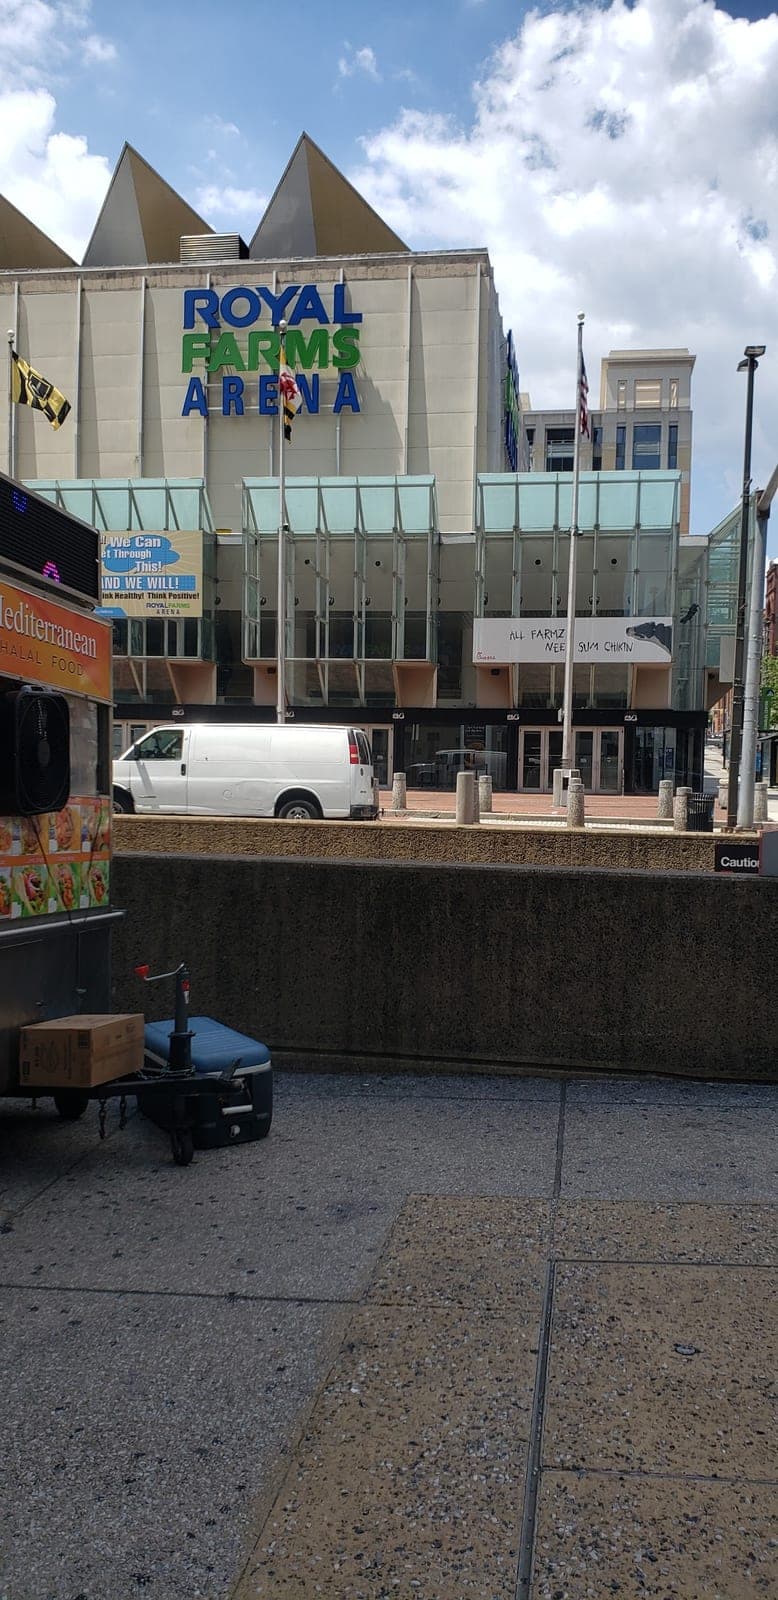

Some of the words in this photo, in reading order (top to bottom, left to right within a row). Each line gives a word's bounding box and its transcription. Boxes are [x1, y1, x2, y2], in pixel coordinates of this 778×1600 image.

[182, 284, 363, 330] ROYAL
[181, 328, 361, 374] FARMS
[181, 372, 361, 416] ARENA
[109, 537, 131, 548] We
[135, 536, 161, 548] Can
[101, 550, 111, 559] et
[113, 549, 152, 560] Through
[135, 561, 163, 573] This!
[125, 576, 144, 590] WE
[147, 576, 179, 590] WILL!
[102, 592, 114, 600] ink
[114, 592, 145, 601] Healthy!
[147, 592, 167, 600] Think
[168, 592, 200, 600] Positive!
[509, 630, 525, 641] ALL
[530, 628, 566, 641] FARMZ
[544, 641, 567, 653] NEE
[578, 640, 600, 653] SUM
[51, 655, 85, 677] FOOD
